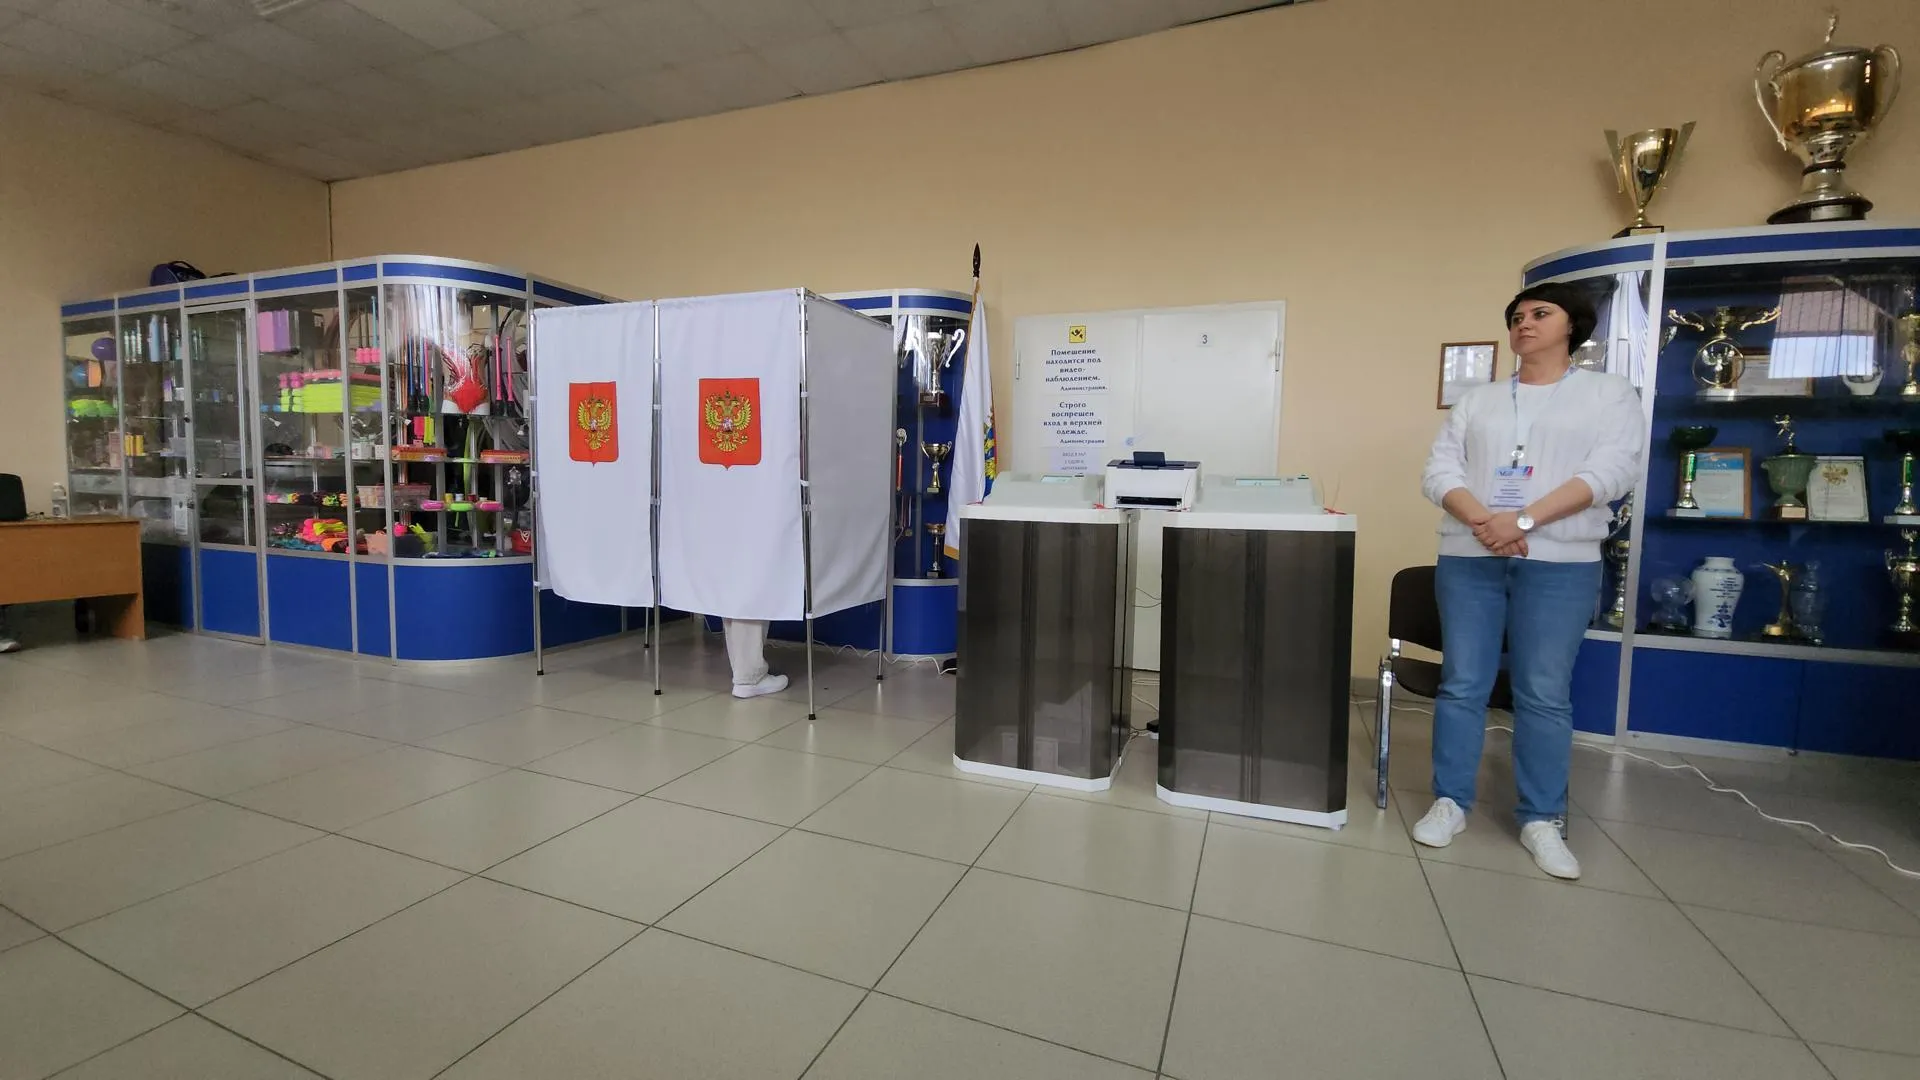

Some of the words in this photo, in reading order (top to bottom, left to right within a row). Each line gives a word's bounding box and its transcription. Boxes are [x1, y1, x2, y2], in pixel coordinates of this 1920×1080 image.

[1202, 334, 1208, 345] 3
[1045, 375, 1101, 383] наблюдением.
[1059, 401, 1087, 410] Строго
[1069, 419, 1103, 428] верхней
